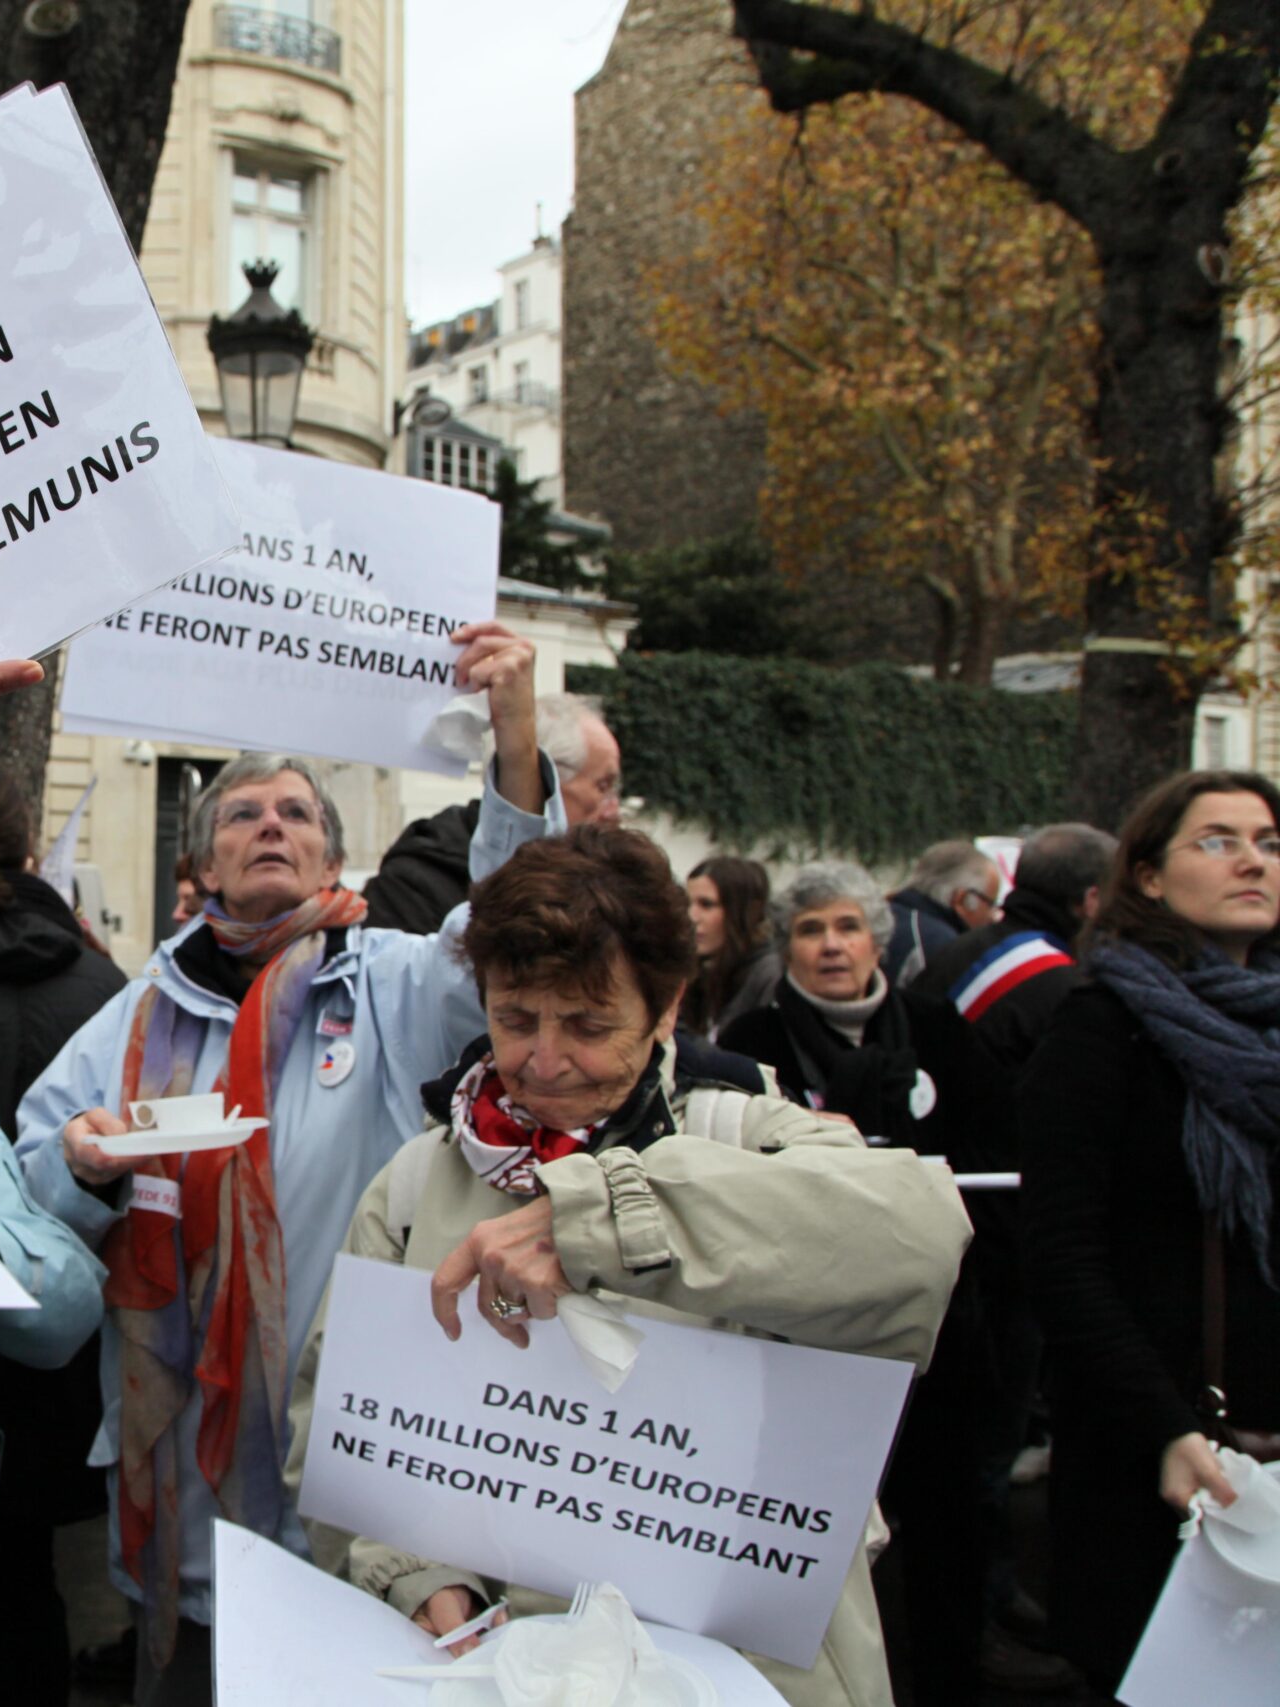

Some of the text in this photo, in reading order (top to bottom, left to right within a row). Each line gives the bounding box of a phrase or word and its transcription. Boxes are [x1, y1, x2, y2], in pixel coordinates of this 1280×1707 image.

[303, 545, 316, 567] 1
[325, 548, 375, 582] AN,
[138, 611, 252, 650] FERONT
[258, 630, 311, 660] PAS
[482, 1383, 698, 1458] DANS 1 AN,
[340, 1392, 832, 1534] 18 MILLIONS D’EUROPEENS
[331, 1430, 819, 1579] NE FERONT PAS SEMBLANT
